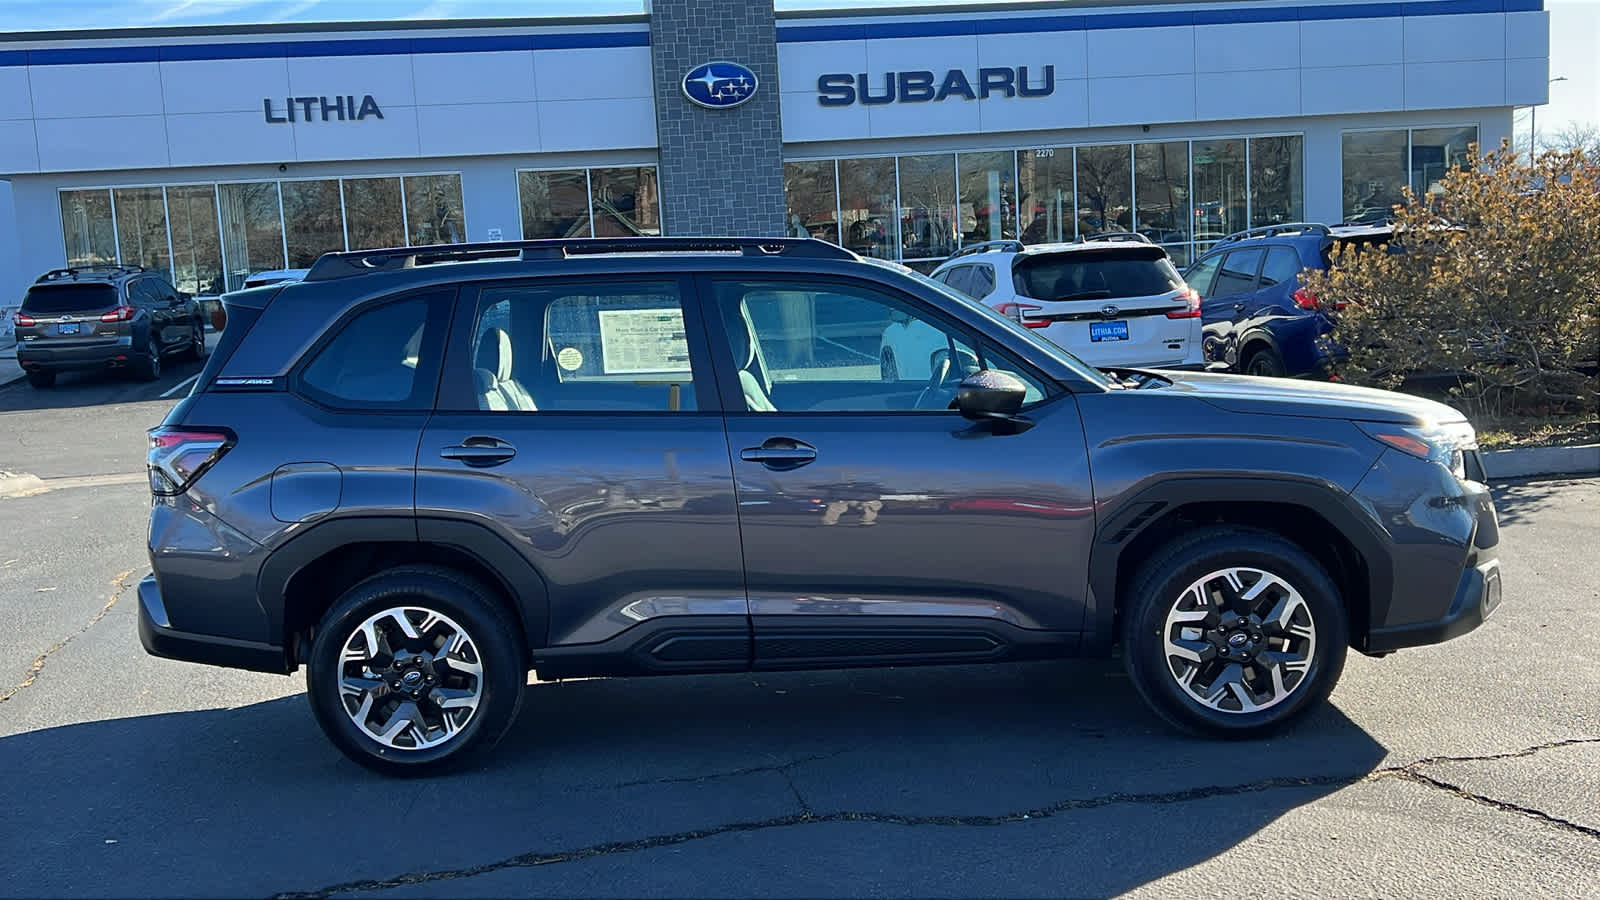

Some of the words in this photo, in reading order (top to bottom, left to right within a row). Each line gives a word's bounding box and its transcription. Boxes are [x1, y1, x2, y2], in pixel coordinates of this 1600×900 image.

[818, 65, 1055, 106] SUBARU
[264, 95, 385, 124] LITHIA
[1036, 149, 1054, 158] 2270
[1091, 327, 1127, 336] LITHIA.COM
